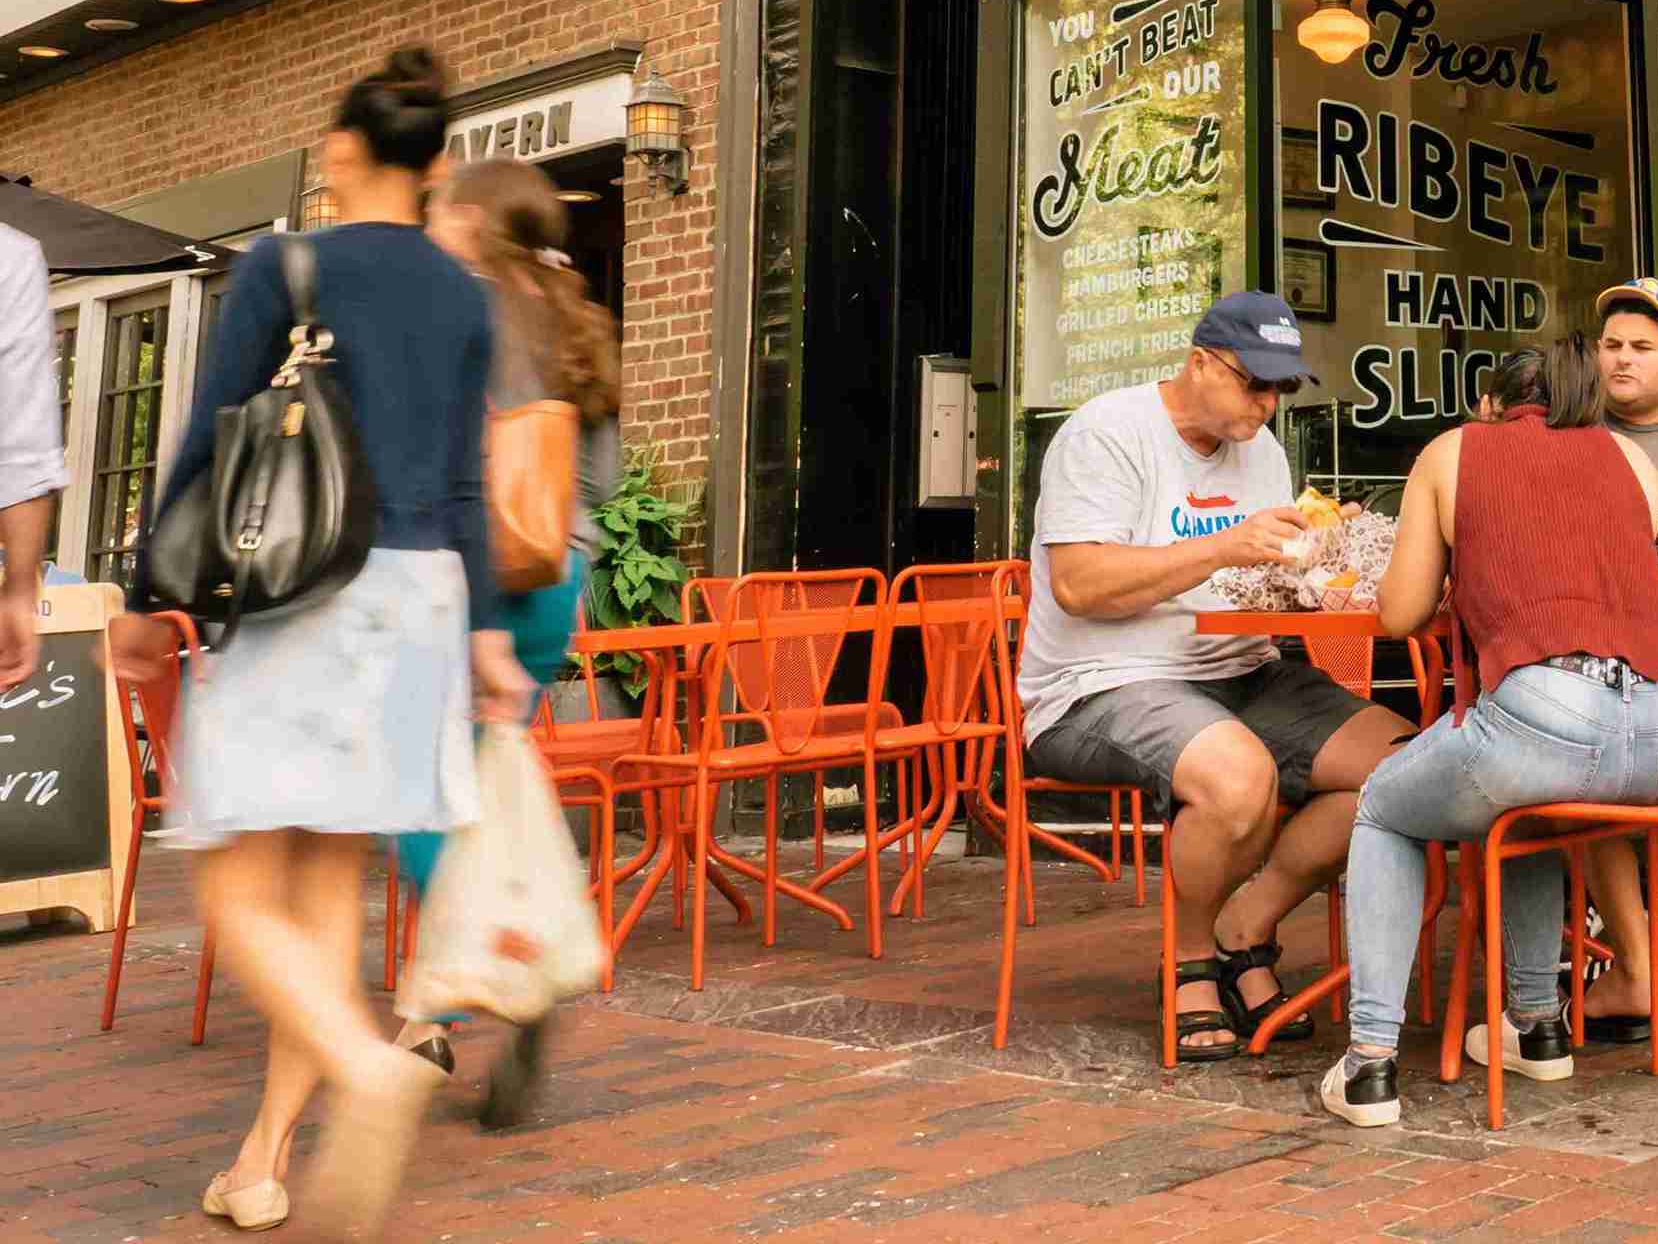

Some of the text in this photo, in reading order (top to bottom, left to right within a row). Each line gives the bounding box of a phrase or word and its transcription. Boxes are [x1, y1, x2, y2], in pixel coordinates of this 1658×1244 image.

[1049, 12, 1096, 49] YOU
[1049, 37, 1128, 108] CAN'T
[1163, 60, 1222, 100] OUR
[449, 100, 573, 159] AVERN
[1317, 99, 1605, 264] RIBEYE
[1063, 228, 1195, 269] CHEESESTEAKS
[1069, 261, 1190, 298] HAMBURGERS
[1056, 292, 1203, 334] GRILLED CHEESE
[1384, 269, 1550, 334] HAND
[1067, 330, 1192, 365] FRENCH FRIES
[1352, 344, 1497, 430] SLIC
